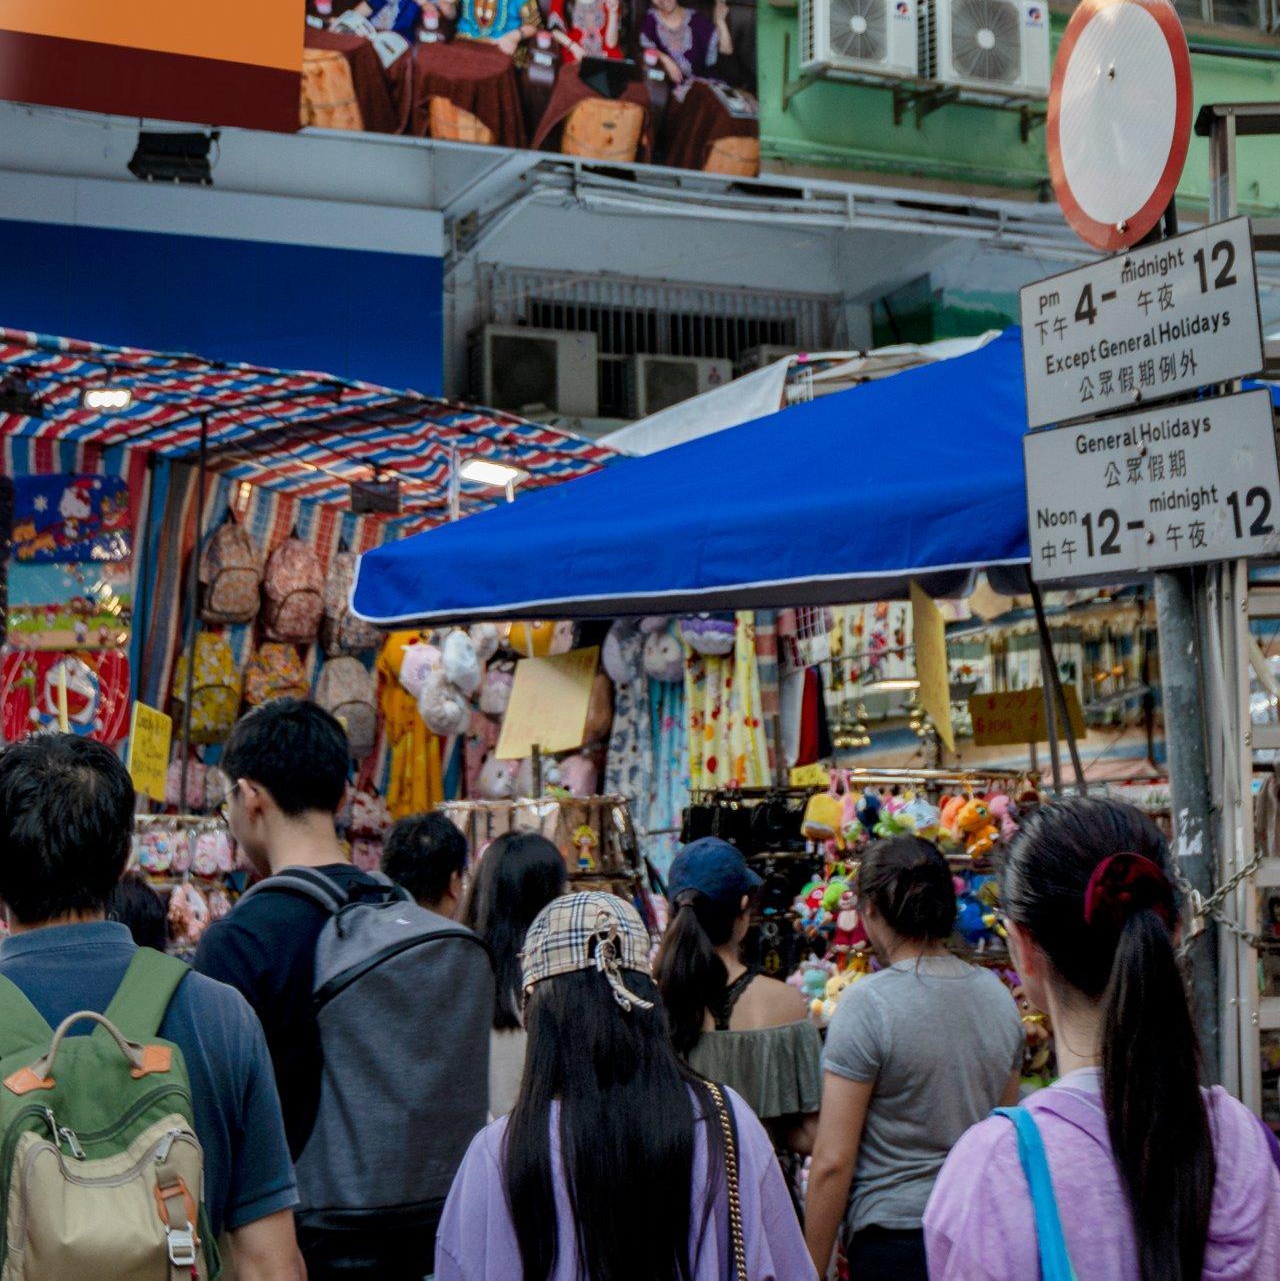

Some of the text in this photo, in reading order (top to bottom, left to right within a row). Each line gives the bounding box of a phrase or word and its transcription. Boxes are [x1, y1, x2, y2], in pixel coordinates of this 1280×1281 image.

[1039, 291, 1061, 315] pm
[1121, 247, 1185, 285] midnight
[1193, 240, 1239, 295] 12
[1034, 282, 1176, 347] 下午 午夜
[1046, 309, 1231, 376] Except General Holidays
[1075, 415, 1212, 455] General Holidays
[1104, 449, 1188, 489] 公眾假期
[1036, 508, 1078, 530] Noon
[1149, 484, 1219, 513] midnight
[1226, 486, 1275, 539] 12
[1040, 520, 1209, 567] 中午 午夜
